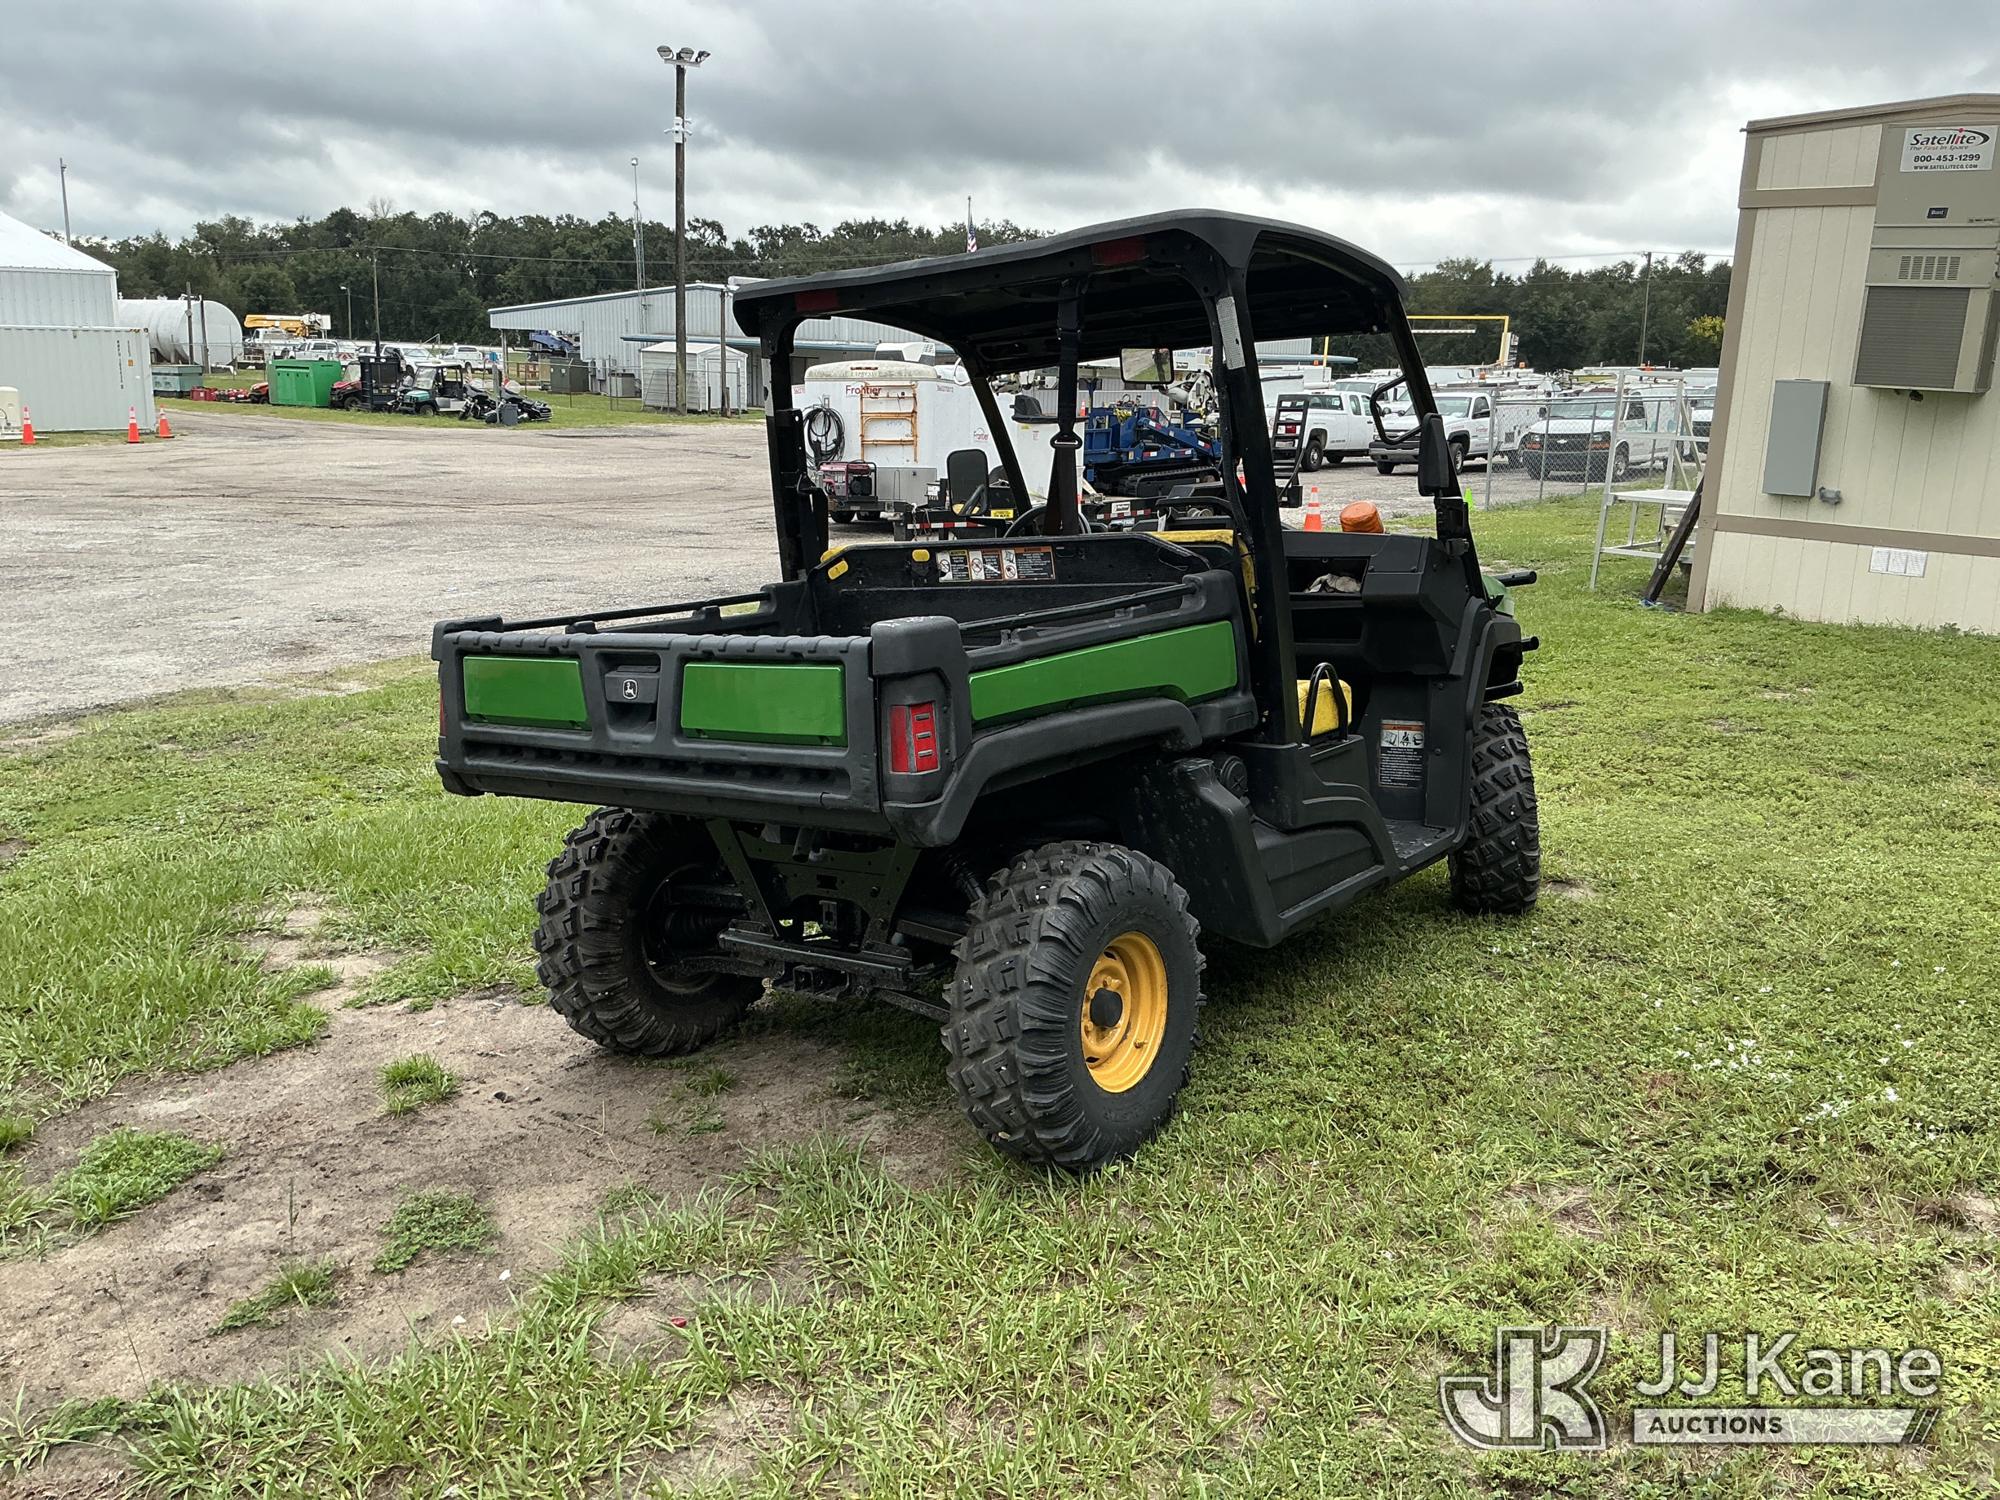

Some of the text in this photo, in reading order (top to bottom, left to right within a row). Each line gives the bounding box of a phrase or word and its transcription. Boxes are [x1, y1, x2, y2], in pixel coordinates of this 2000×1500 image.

[1910, 133, 1977, 146] Satellite
[1913, 153, 1981, 163] 800-453-1299
[845, 385, 882, 395] Frontier
